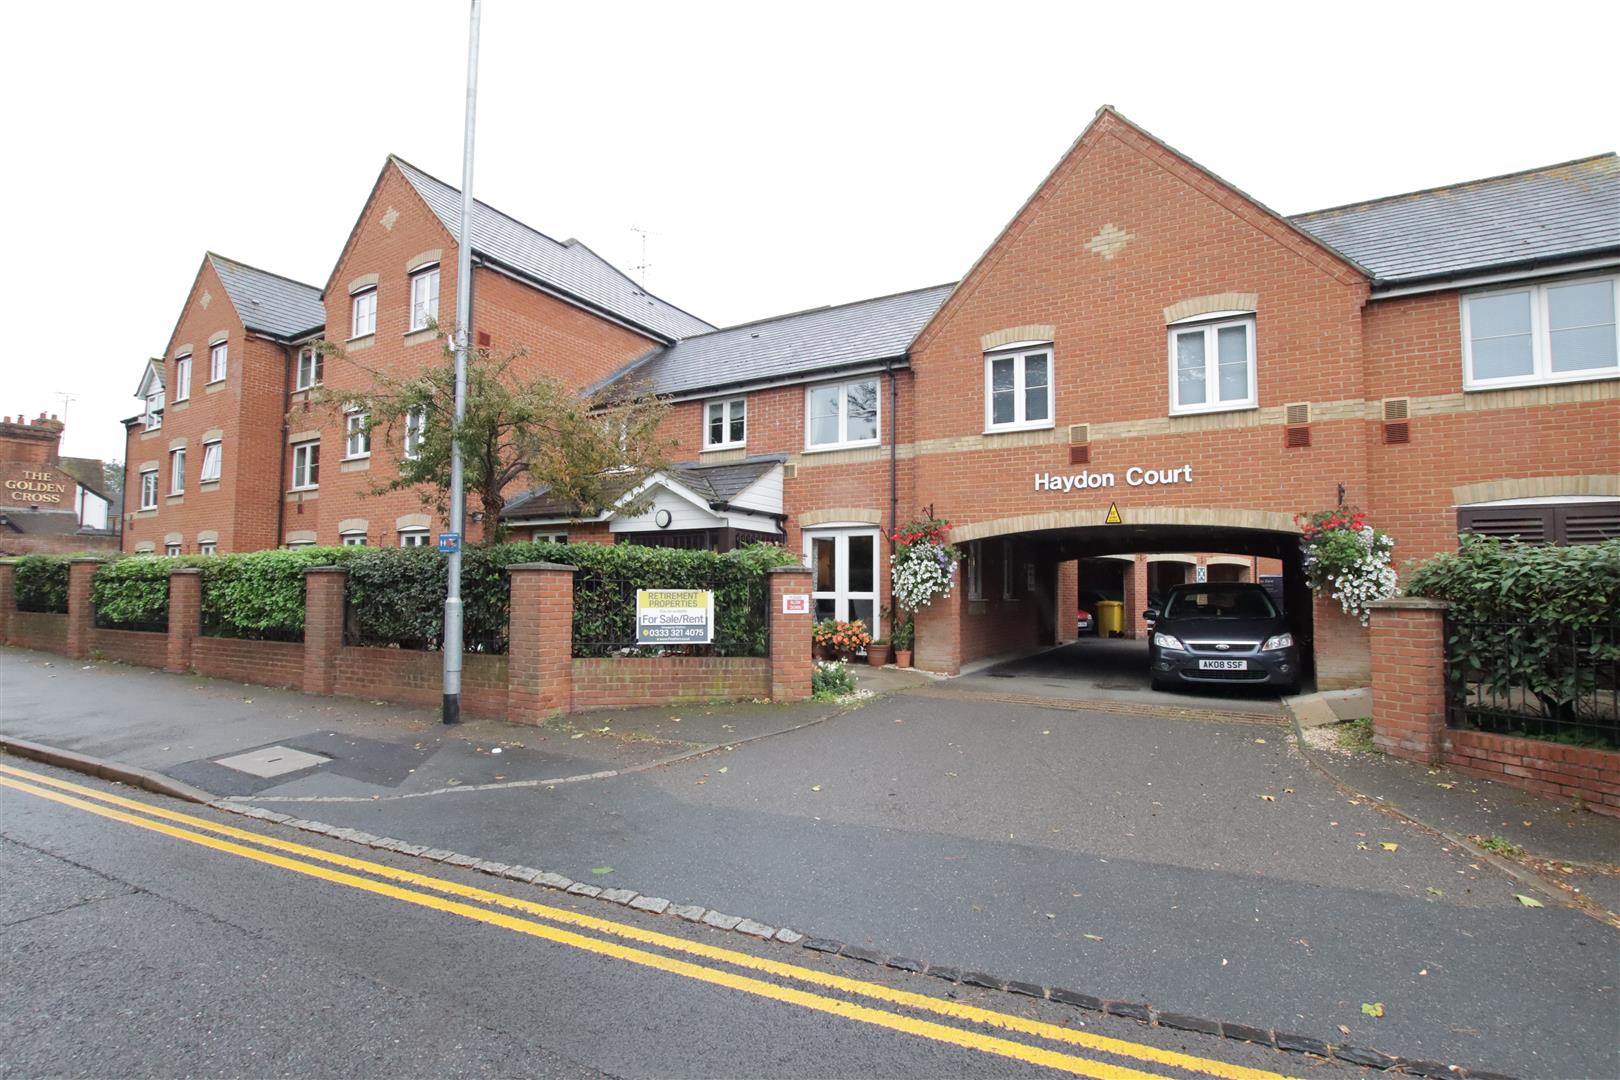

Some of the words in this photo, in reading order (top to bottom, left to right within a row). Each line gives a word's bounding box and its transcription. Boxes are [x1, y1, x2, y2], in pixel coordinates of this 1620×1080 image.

[22, 470, 52, 481] THE
[1034, 470, 1115, 493] Haydon
[1126, 464, 1193, 486] Court
[5, 480, 65, 493] GOLDEN
[11, 491, 60, 503] CROSS
[648, 592, 698, 600] RETIREMENT
[648, 599, 698, 608] PROPERTIES
[642, 614, 658, 624] For
[659, 614, 704, 624] Sale/Rent
[649, 628, 669, 637] 0333
[670, 628, 684, 637] 321
[684, 628, 704, 637] 4075
[1203, 661, 1225, 669] AK08
[1227, 661, 1243, 669] SSF
